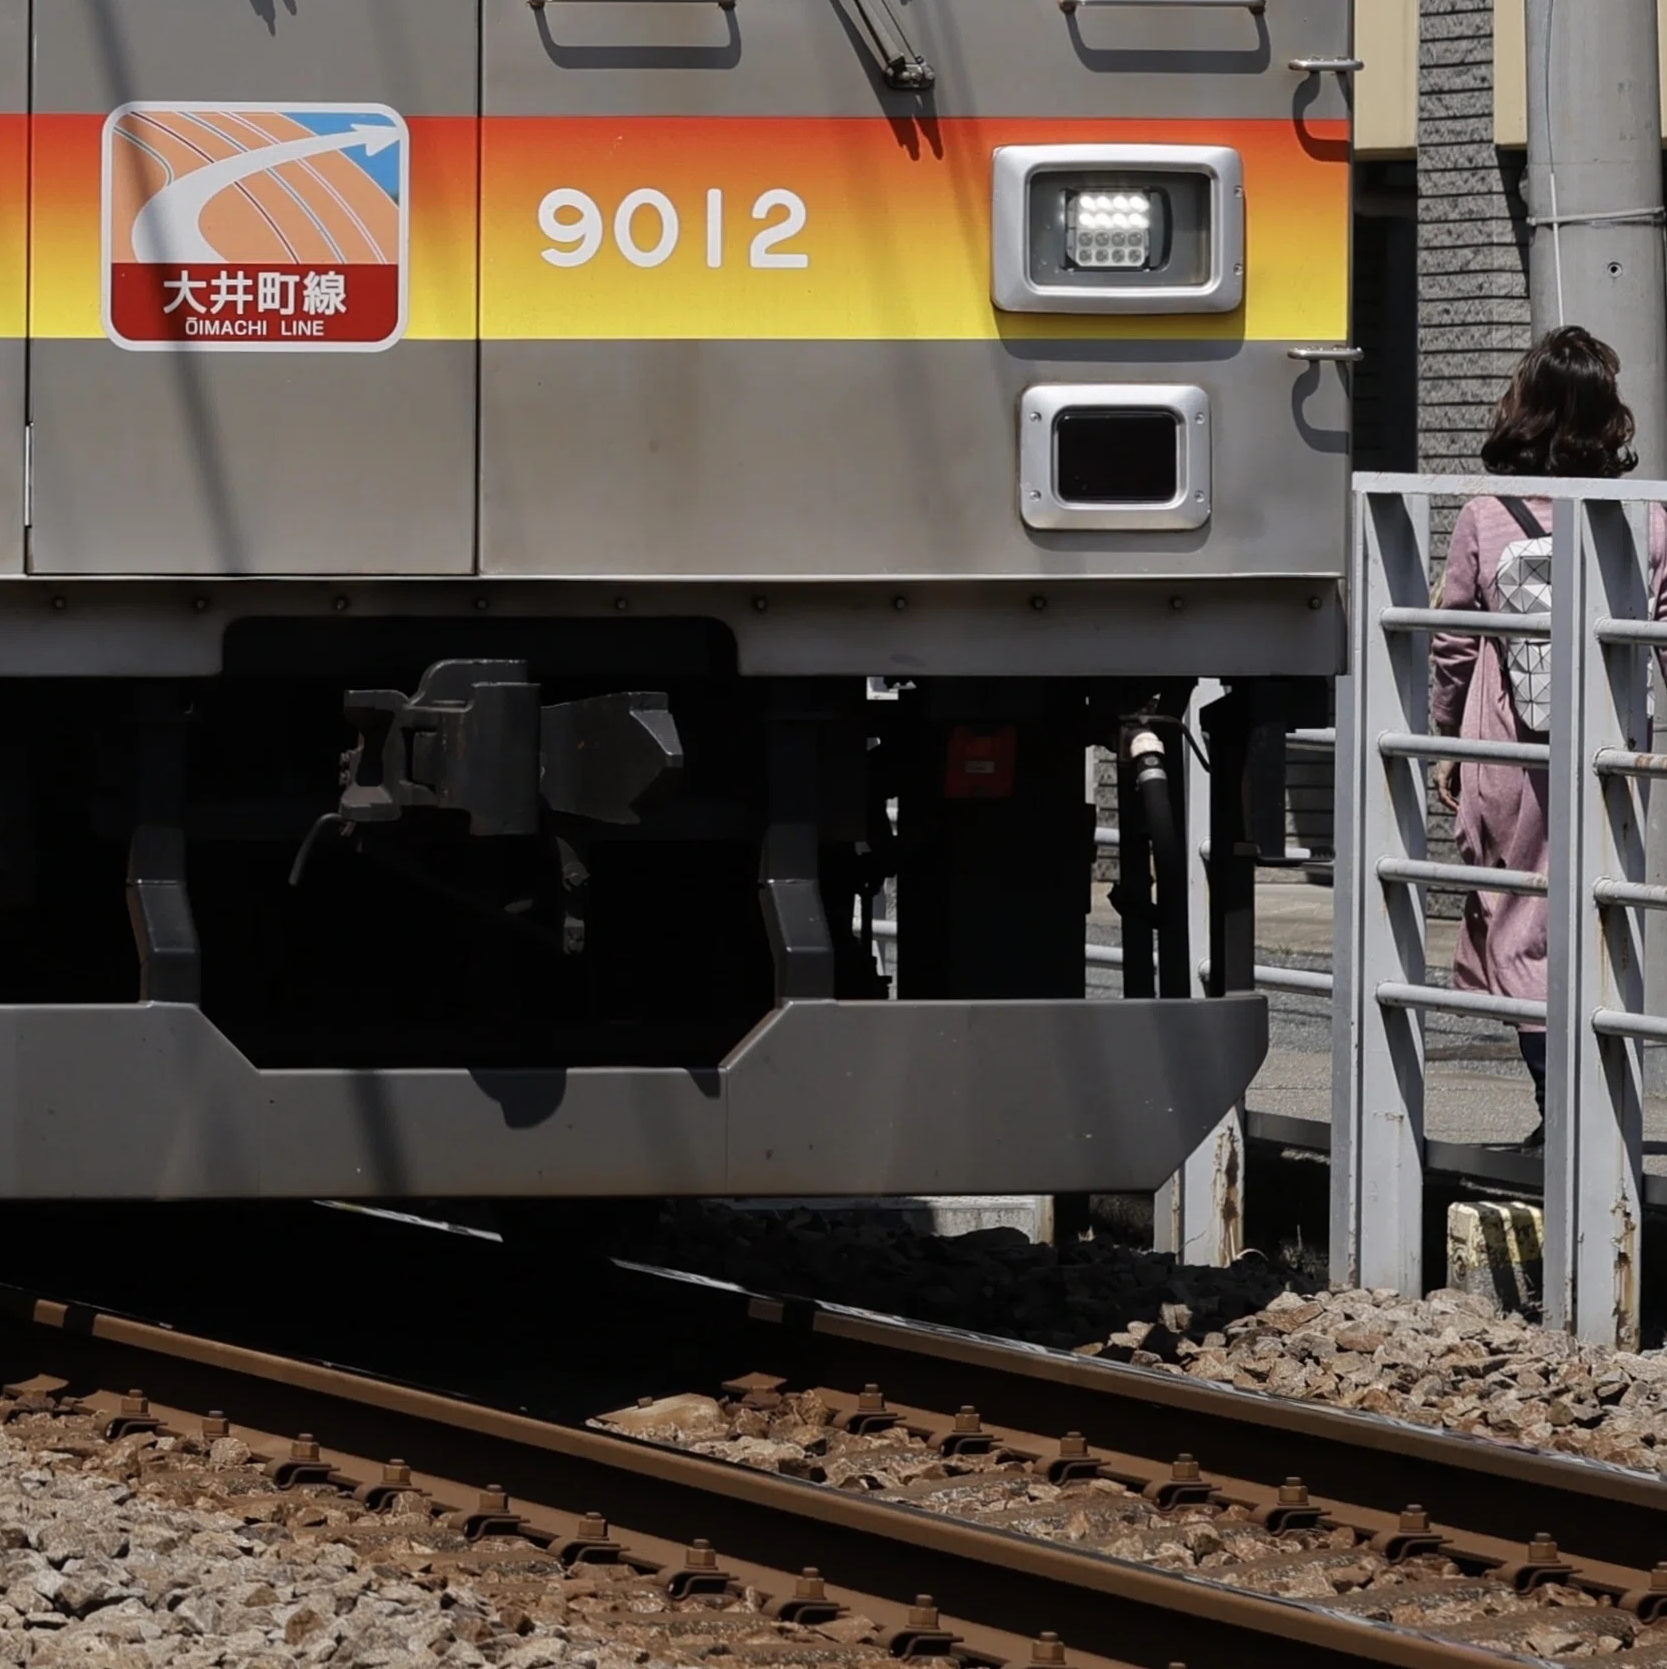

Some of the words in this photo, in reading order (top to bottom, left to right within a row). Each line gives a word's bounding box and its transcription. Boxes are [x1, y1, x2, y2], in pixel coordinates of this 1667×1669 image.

[537, 187, 809, 268] 9012
[163, 270, 347, 316] 大井町線
[185, 316, 267, 336] ŌIMACHI
[281, 320, 325, 336] LINE
